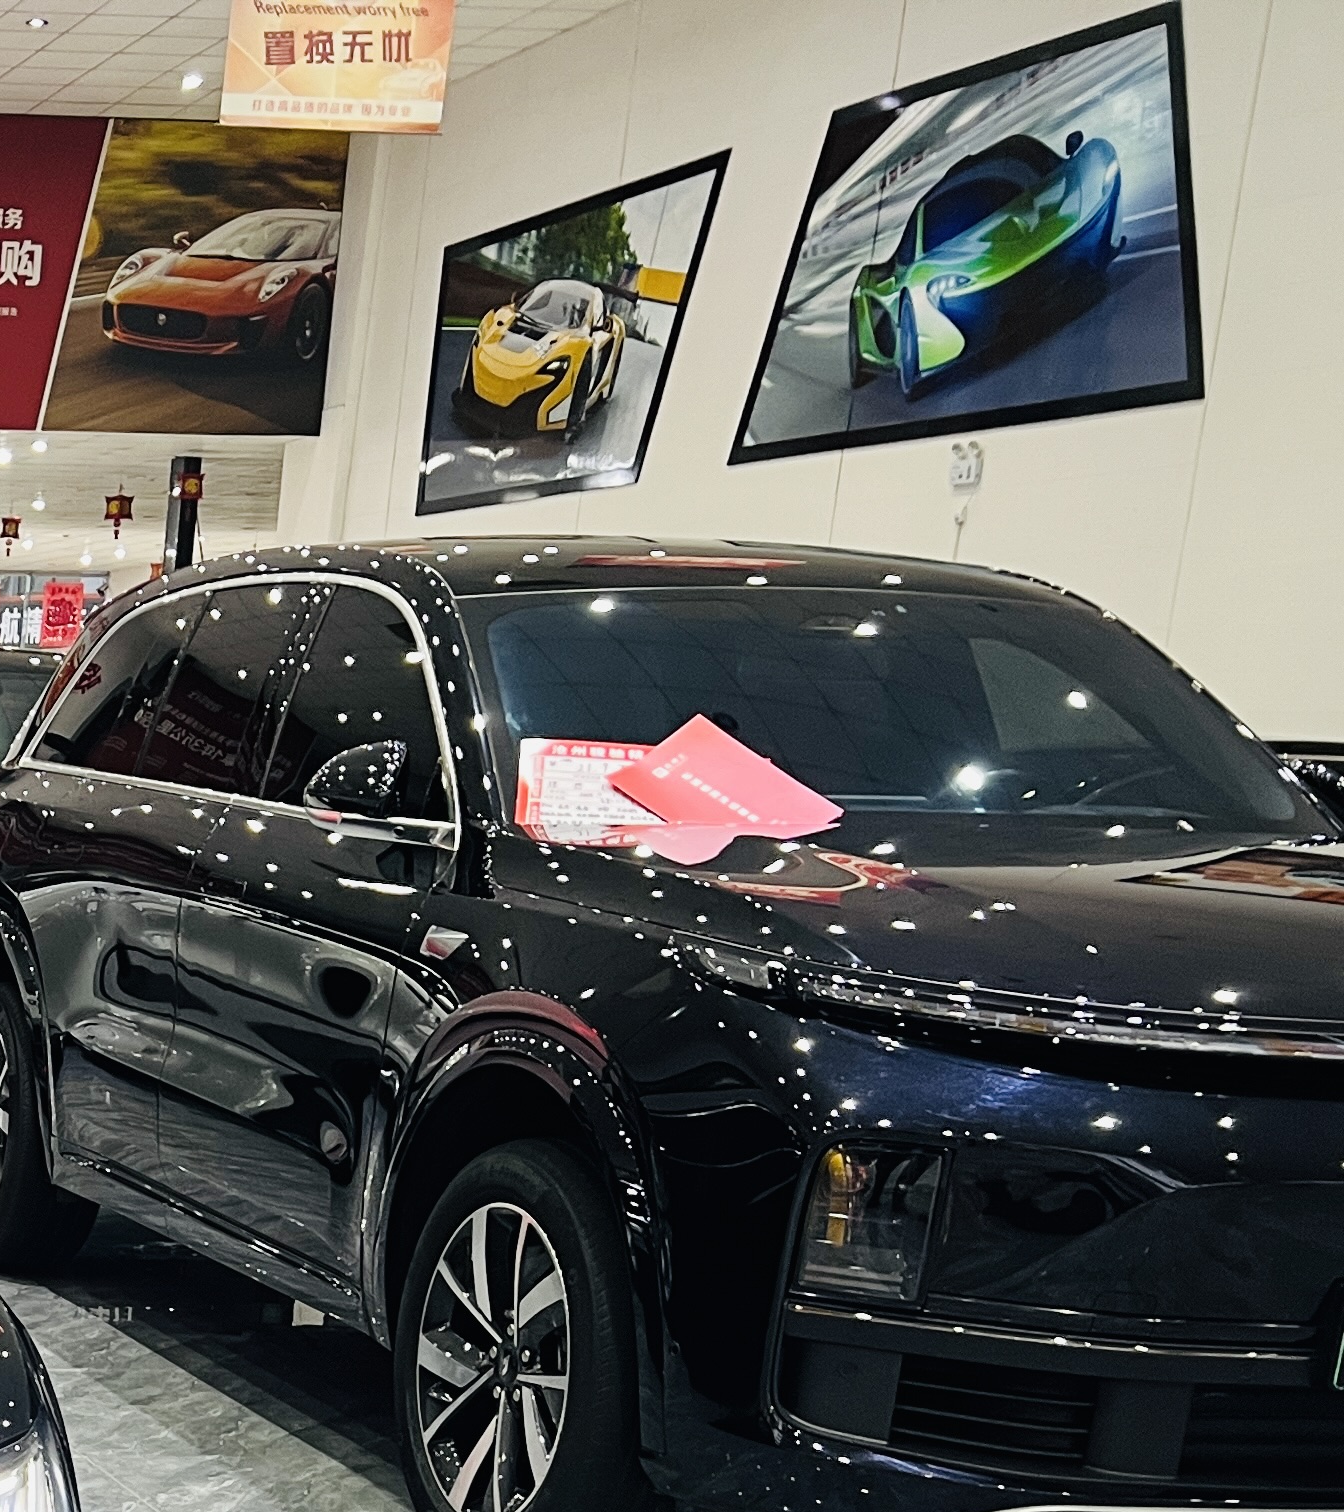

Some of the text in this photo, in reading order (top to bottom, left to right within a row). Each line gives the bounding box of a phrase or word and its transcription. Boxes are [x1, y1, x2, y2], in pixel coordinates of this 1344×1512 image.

[355, 4, 397, 20] worry
[399, 4, 429, 18] free
[263, 29, 412, 66] 置换无忧
